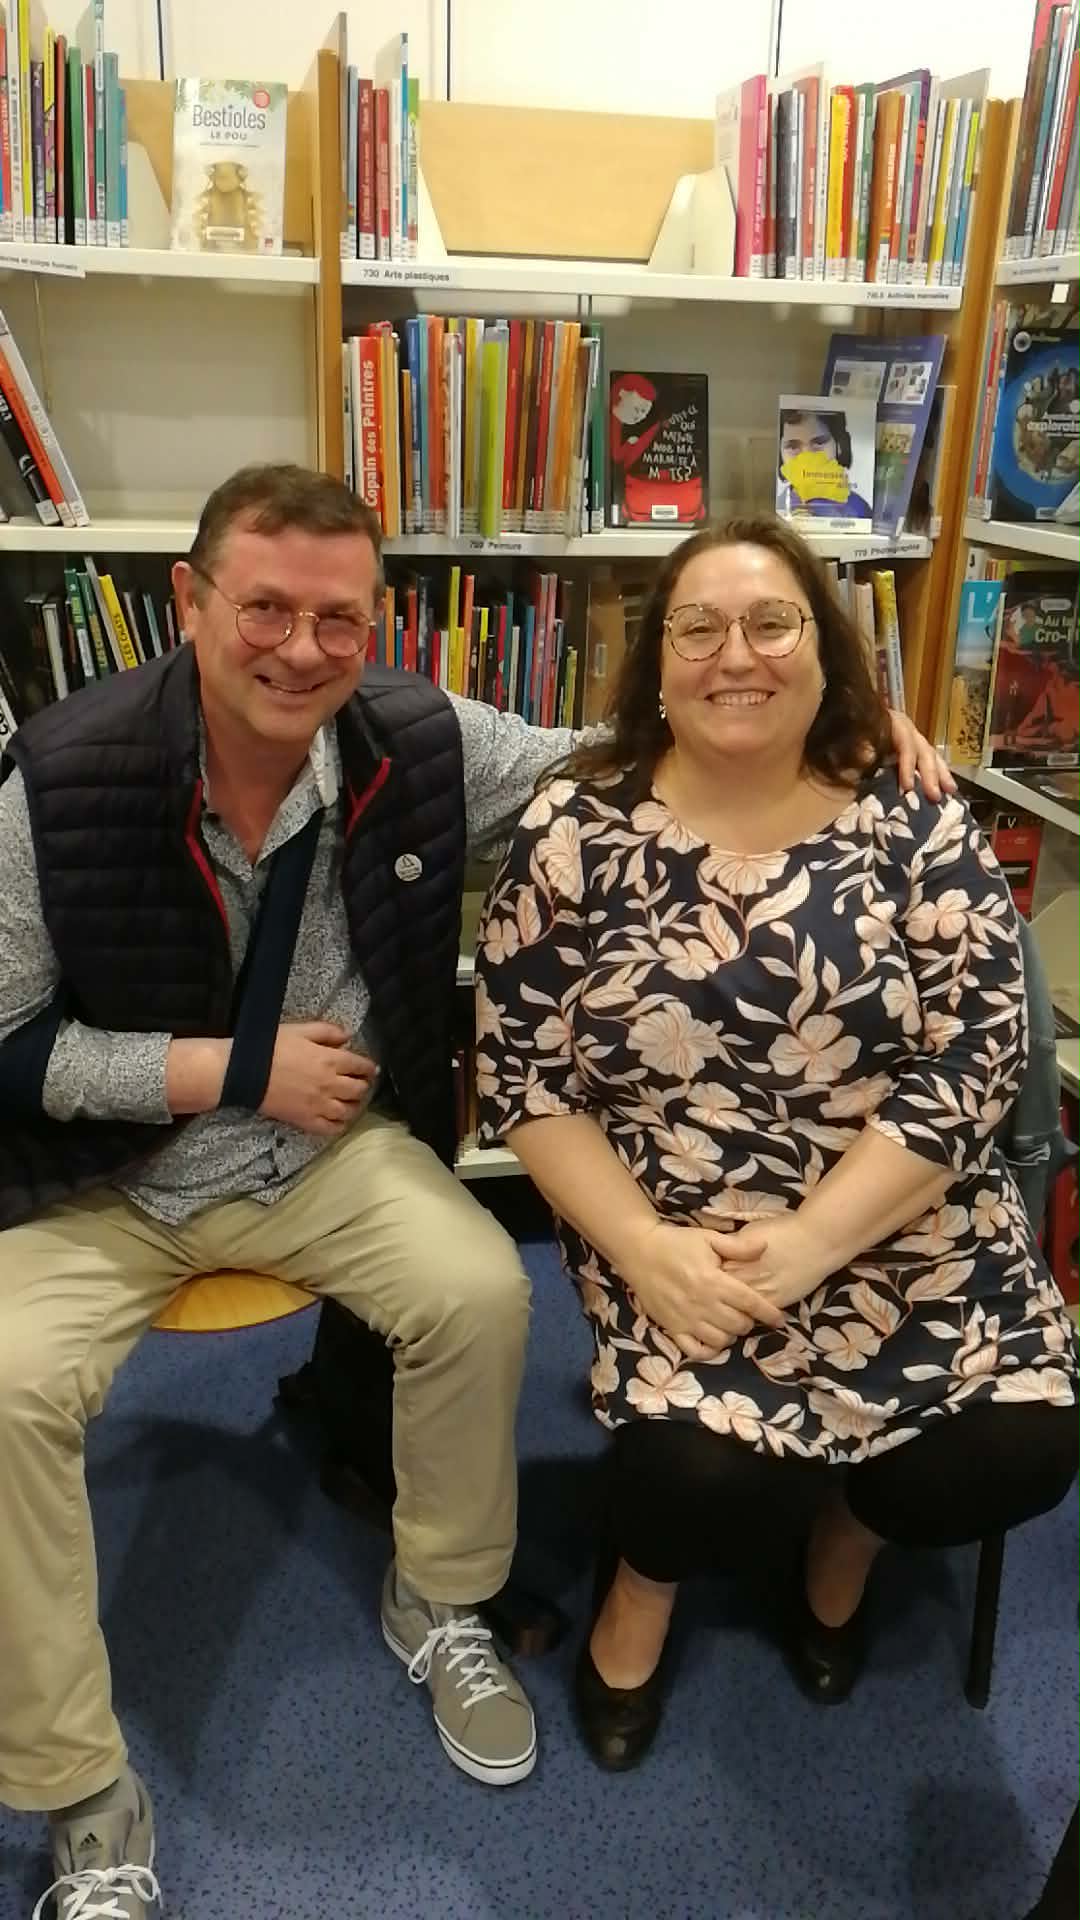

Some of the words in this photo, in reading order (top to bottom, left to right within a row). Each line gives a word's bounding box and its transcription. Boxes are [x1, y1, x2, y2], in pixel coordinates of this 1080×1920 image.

[192, 104, 267, 130] Bestioles
[404, 271, 450, 283] plastiques
[361, 359, 377, 428] Peintres
[366, 430, 377, 454] des
[363, 456, 381, 508] Copain
